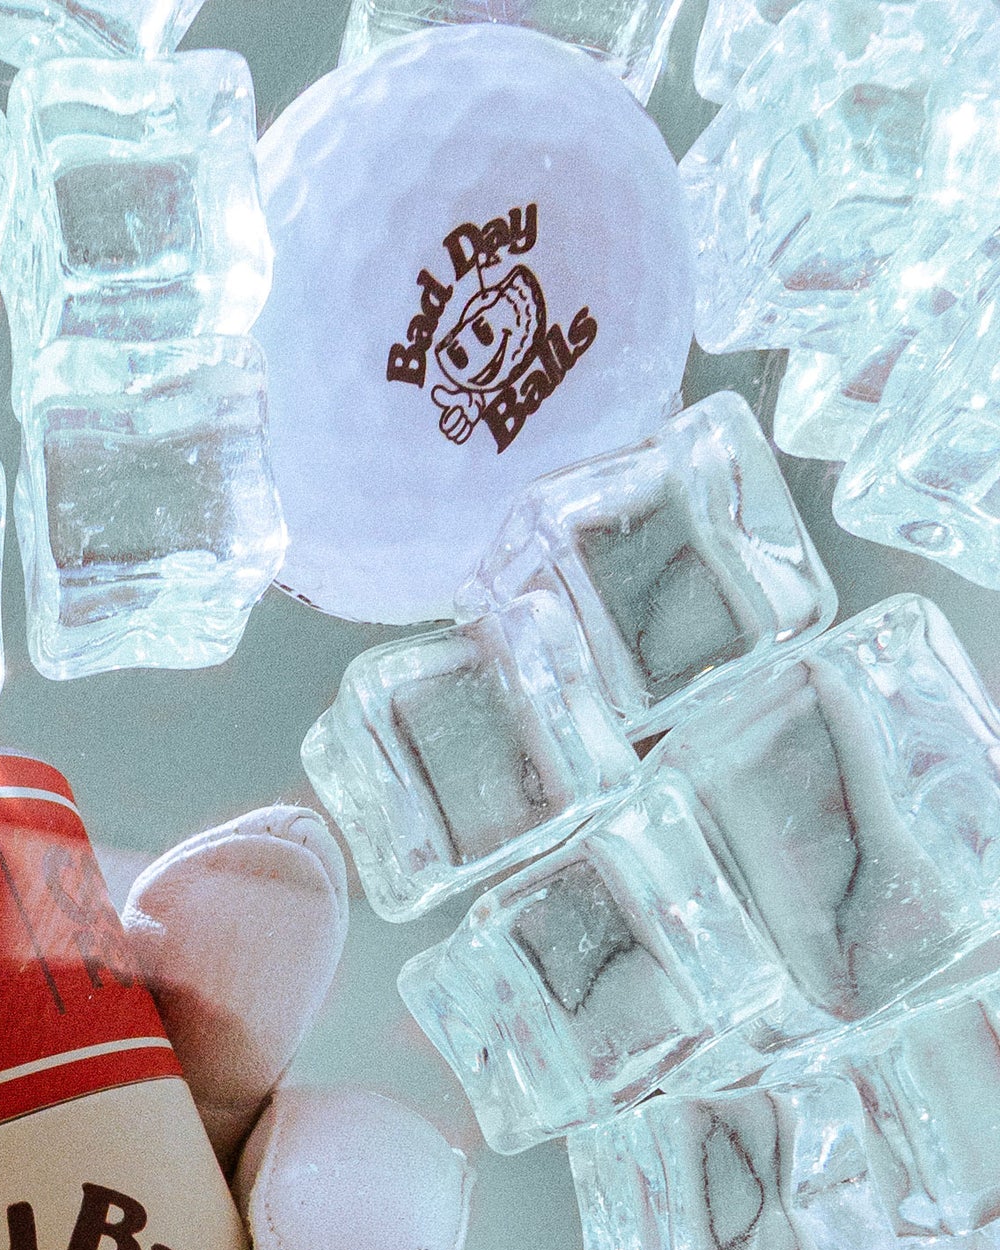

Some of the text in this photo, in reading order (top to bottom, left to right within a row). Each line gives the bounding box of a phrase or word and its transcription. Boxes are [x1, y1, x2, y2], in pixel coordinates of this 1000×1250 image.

[386, 203, 598, 454] Bad Day Balls
